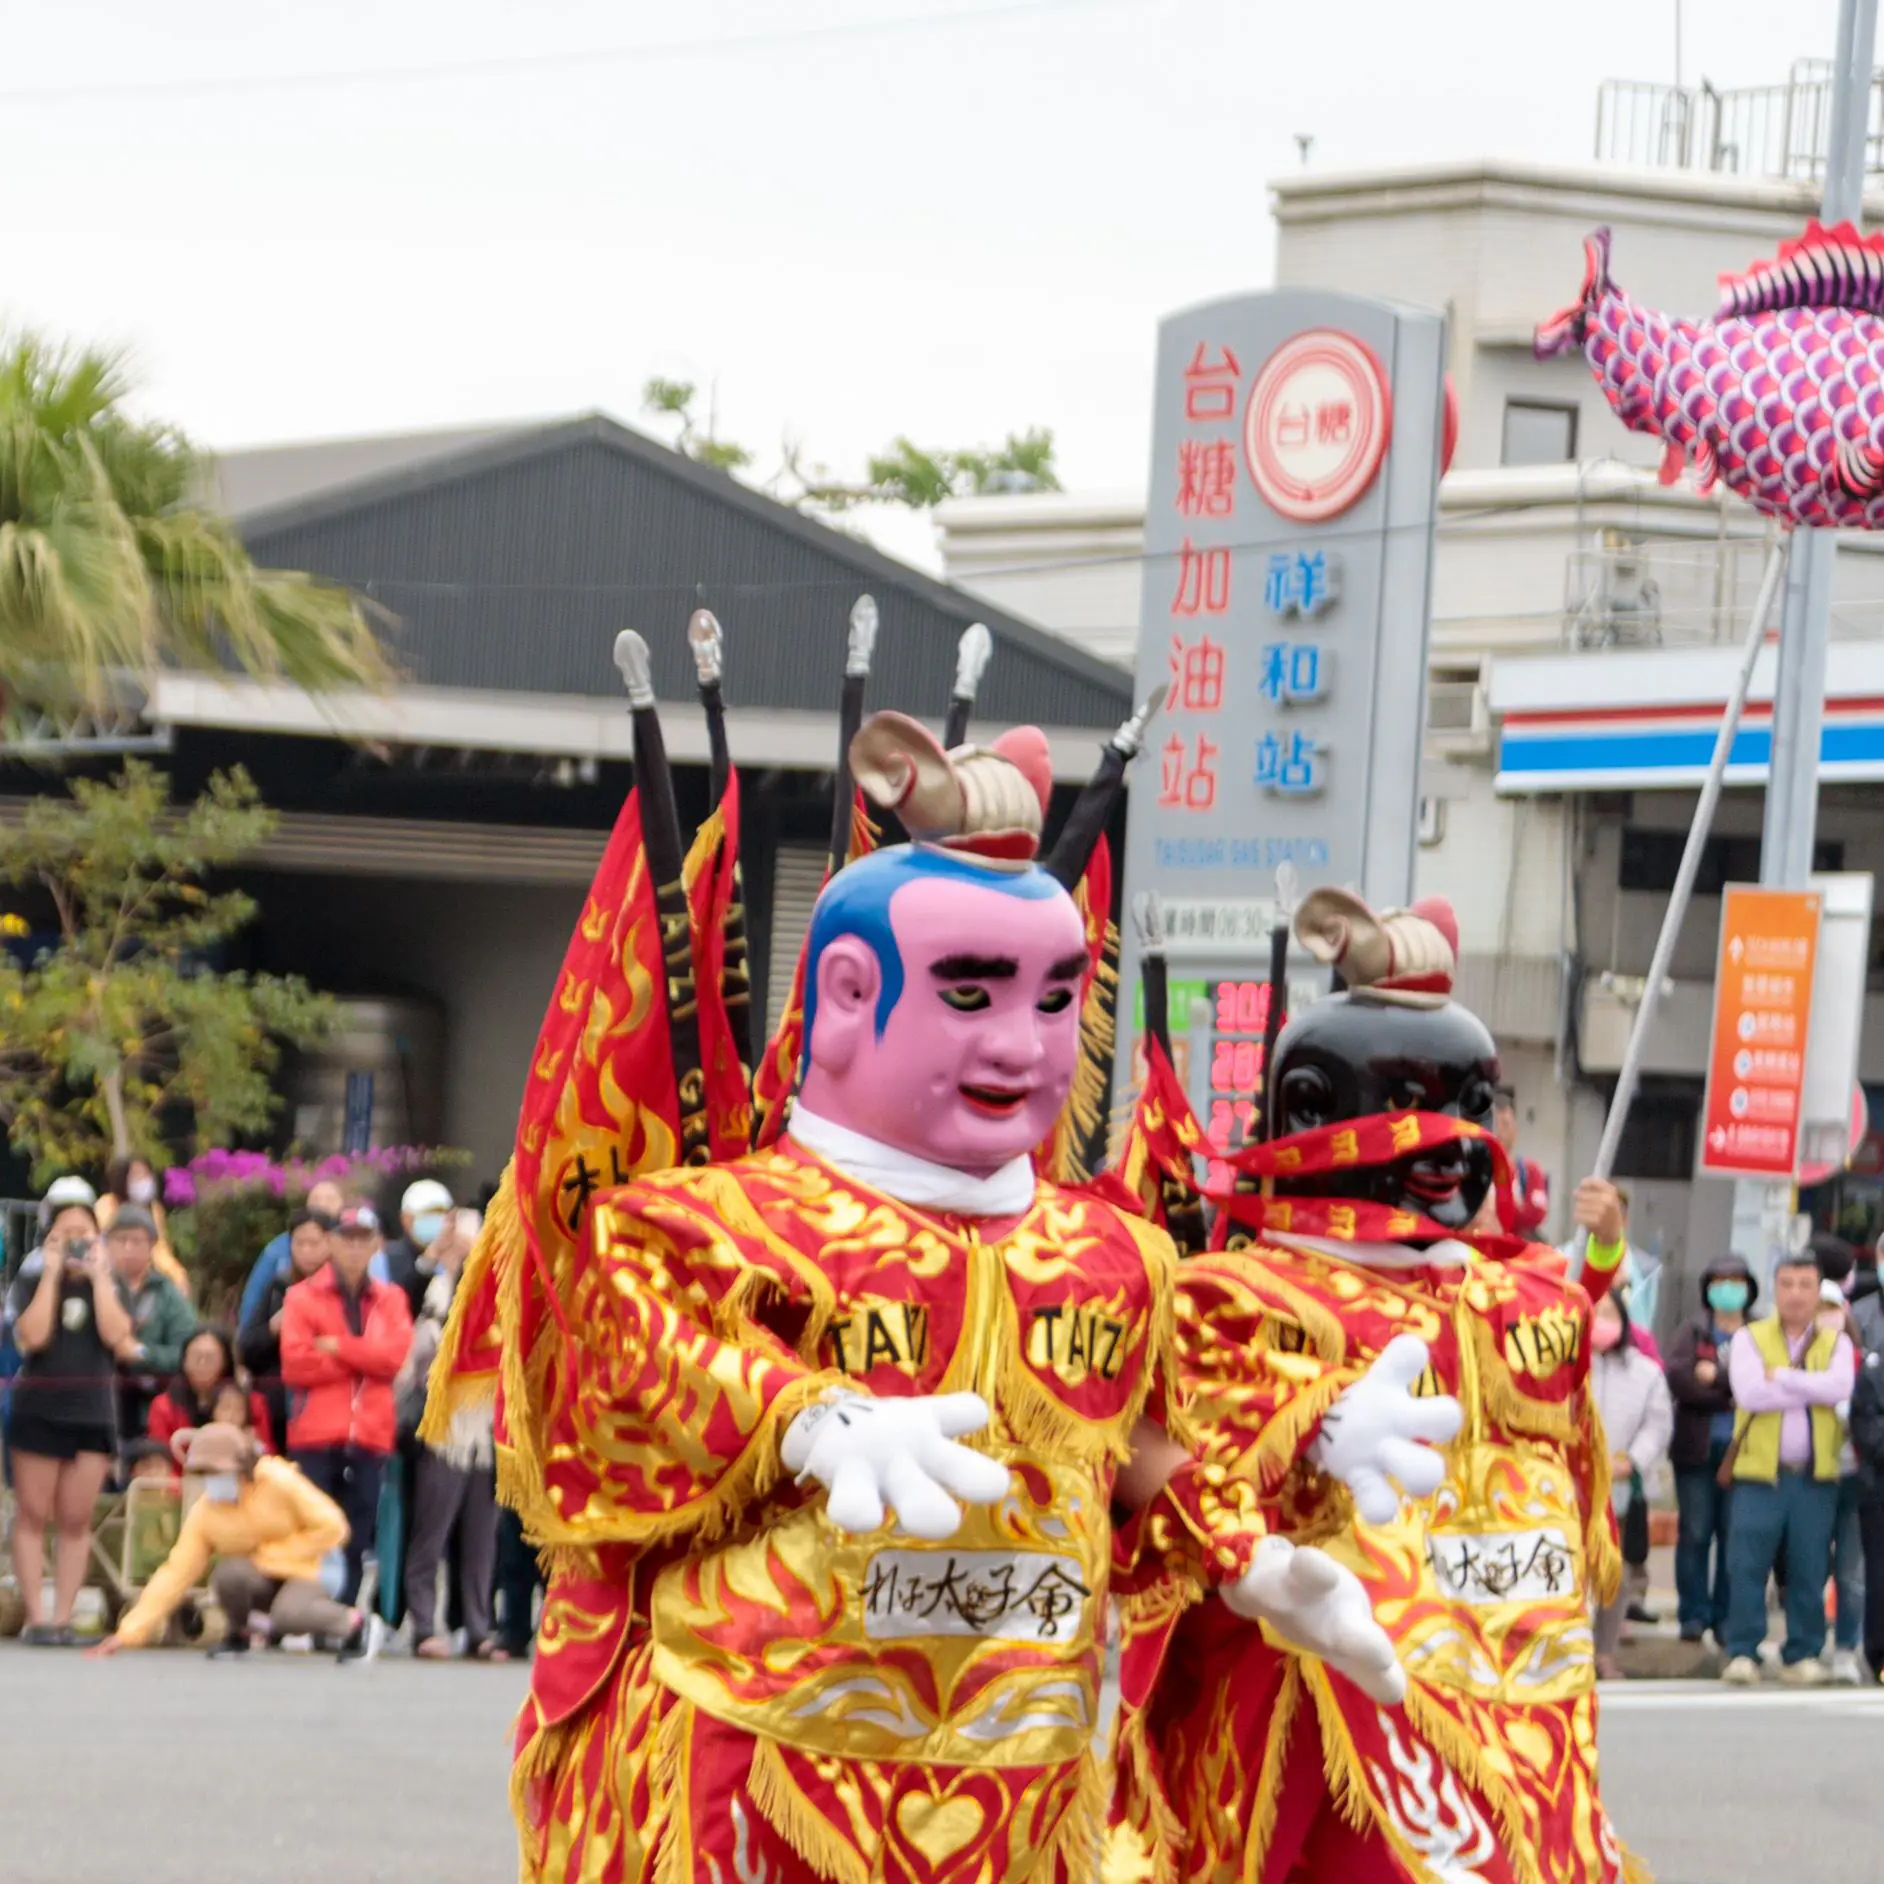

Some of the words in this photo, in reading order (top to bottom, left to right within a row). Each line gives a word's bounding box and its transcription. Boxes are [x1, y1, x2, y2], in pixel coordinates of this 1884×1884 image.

[1277, 401, 1352, 446] 台糖
[1158, 341, 1240, 810] 台糖加油站
[1254, 549, 1325, 787] 祥和站
